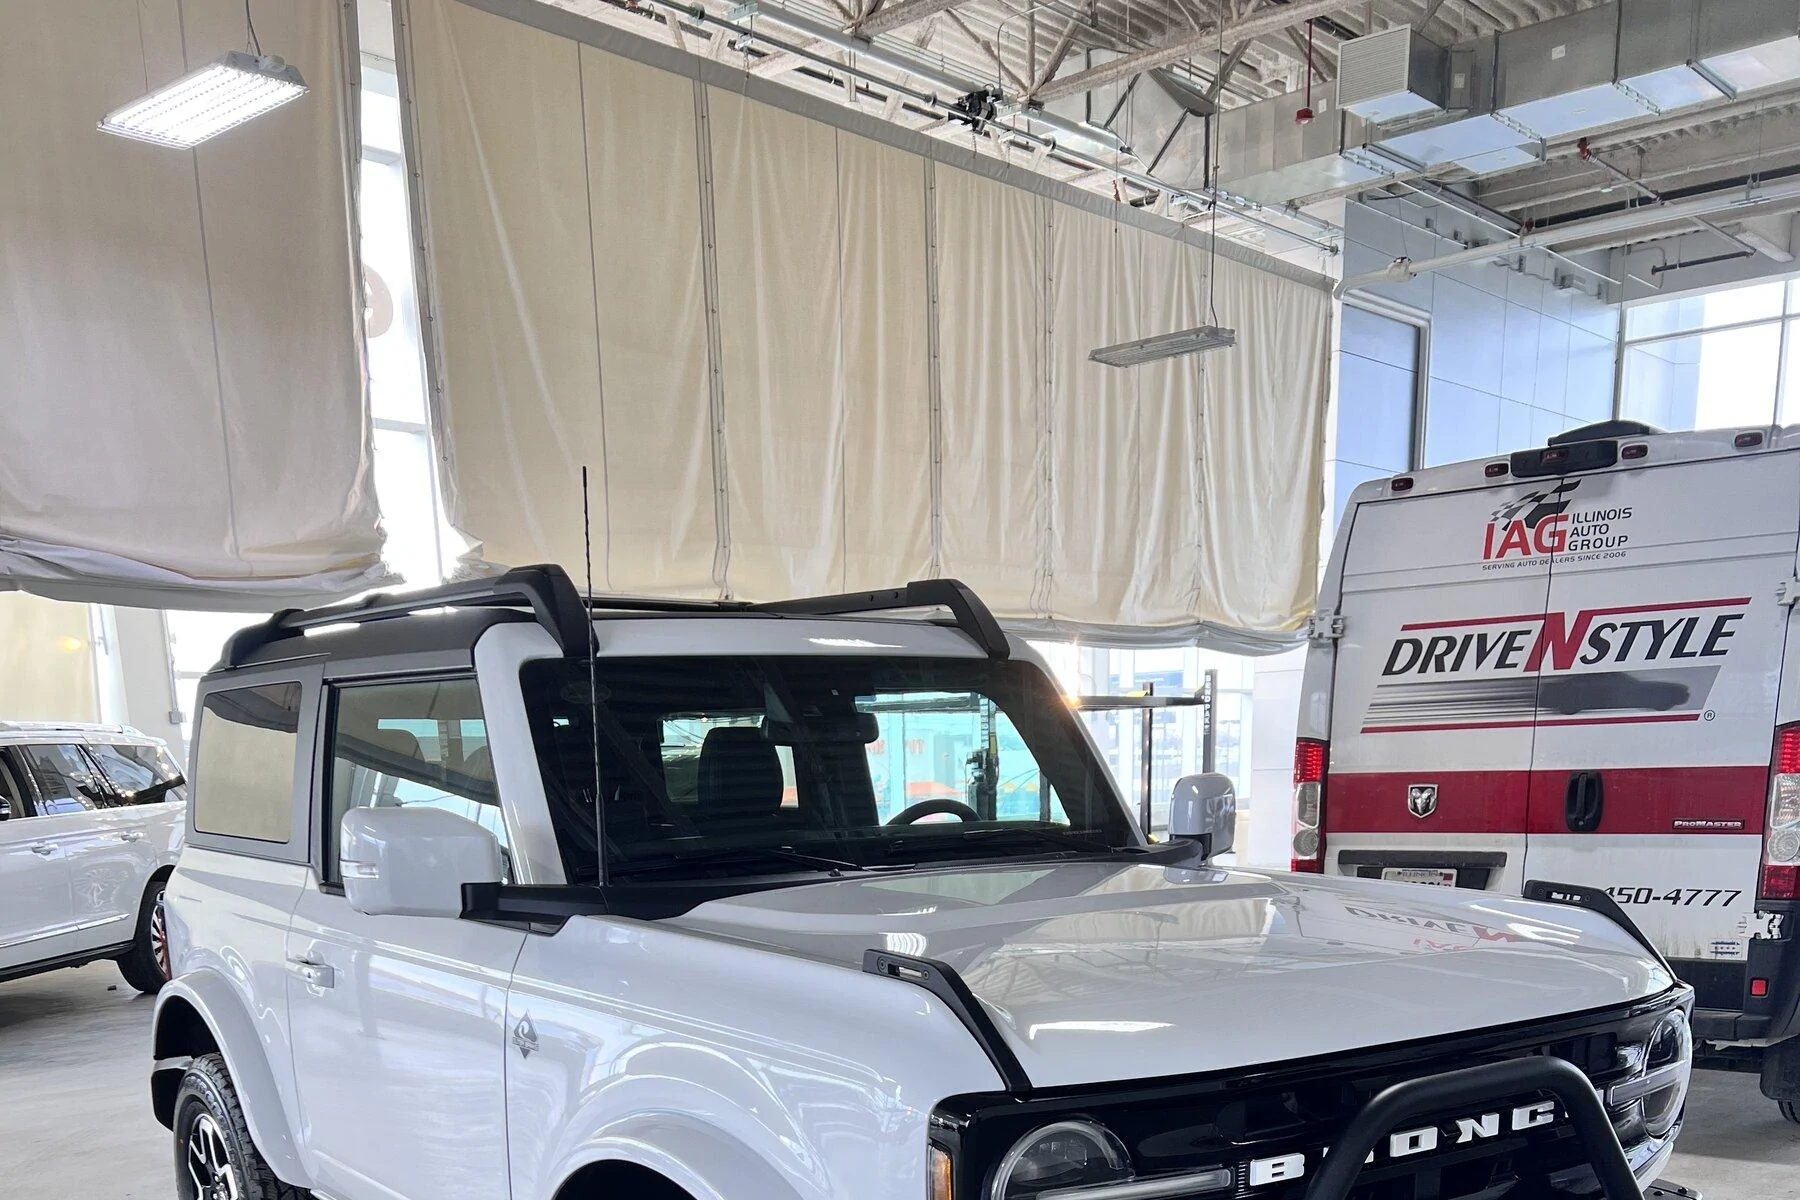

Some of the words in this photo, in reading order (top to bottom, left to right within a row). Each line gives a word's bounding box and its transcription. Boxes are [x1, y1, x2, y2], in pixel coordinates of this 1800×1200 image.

[1571, 507, 1633, 524] ILLINOIS
[1482, 513, 1569, 560] IAG
[1569, 523, 1610, 538] AUTO
[1568, 535, 1629, 551] GROUP
[1482, 562, 1516, 571] SERVING
[1517, 560, 1537, 568] AUTO
[1539, 556, 1576, 565] DEALERS
[1577, 553, 1601, 562] SINCE
[1602, 551, 1627, 559] 2006
[1249, 1090, 1603, 1187] BONC
